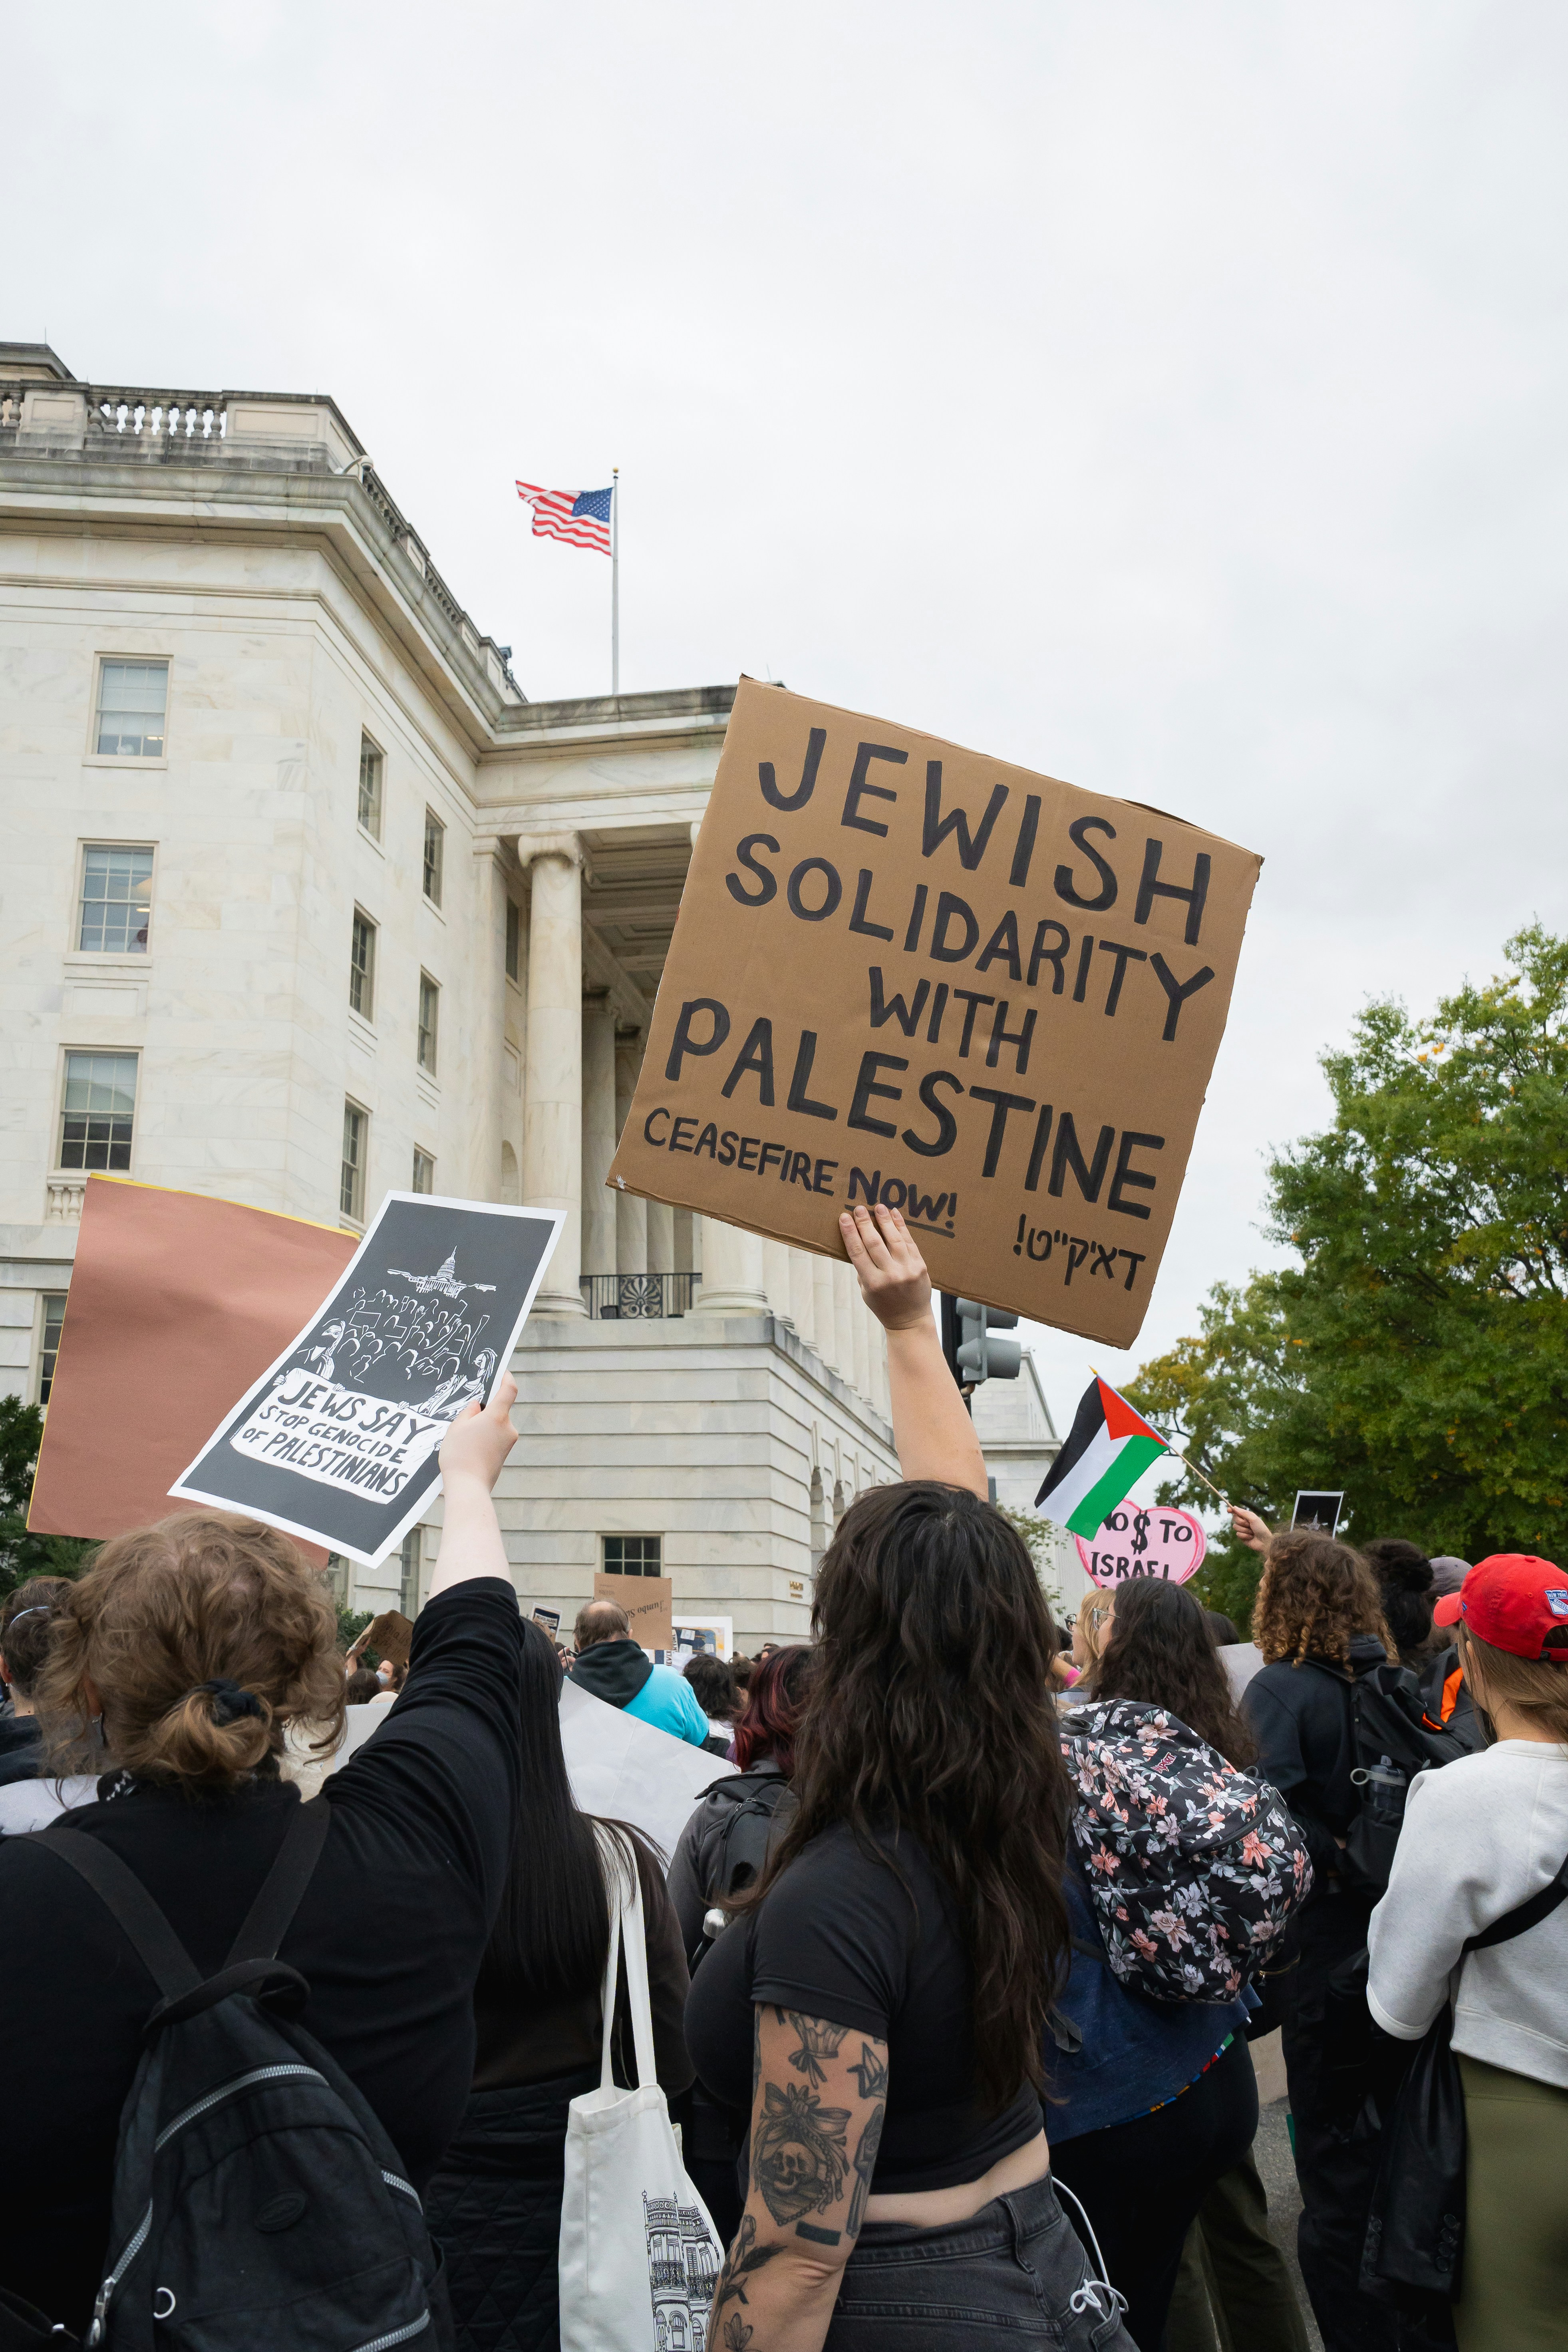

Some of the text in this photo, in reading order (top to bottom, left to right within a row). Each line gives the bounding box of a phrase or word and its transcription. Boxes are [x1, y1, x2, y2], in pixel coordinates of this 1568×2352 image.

[758, 727, 1211, 946] JEWISH
[725, 833, 1215, 1042] SOLIDARITY
[868, 966, 1038, 1075] WITH
[664, 998, 1166, 1220] PALESTINE
[643, 1107, 958, 1231] CEASEFIRE NOW!
[259, 1405, 408, 1464] STOP GENOCIDE
[278, 1381, 437, 1445] JEWS SAY
[242, 1428, 409, 1495] OF PALESTINIANS
[1159, 1519, 1192, 1543] TO
[1091, 1551, 1176, 1583] ISRAEL
[637, 1600, 664, 1614] Jumbo
